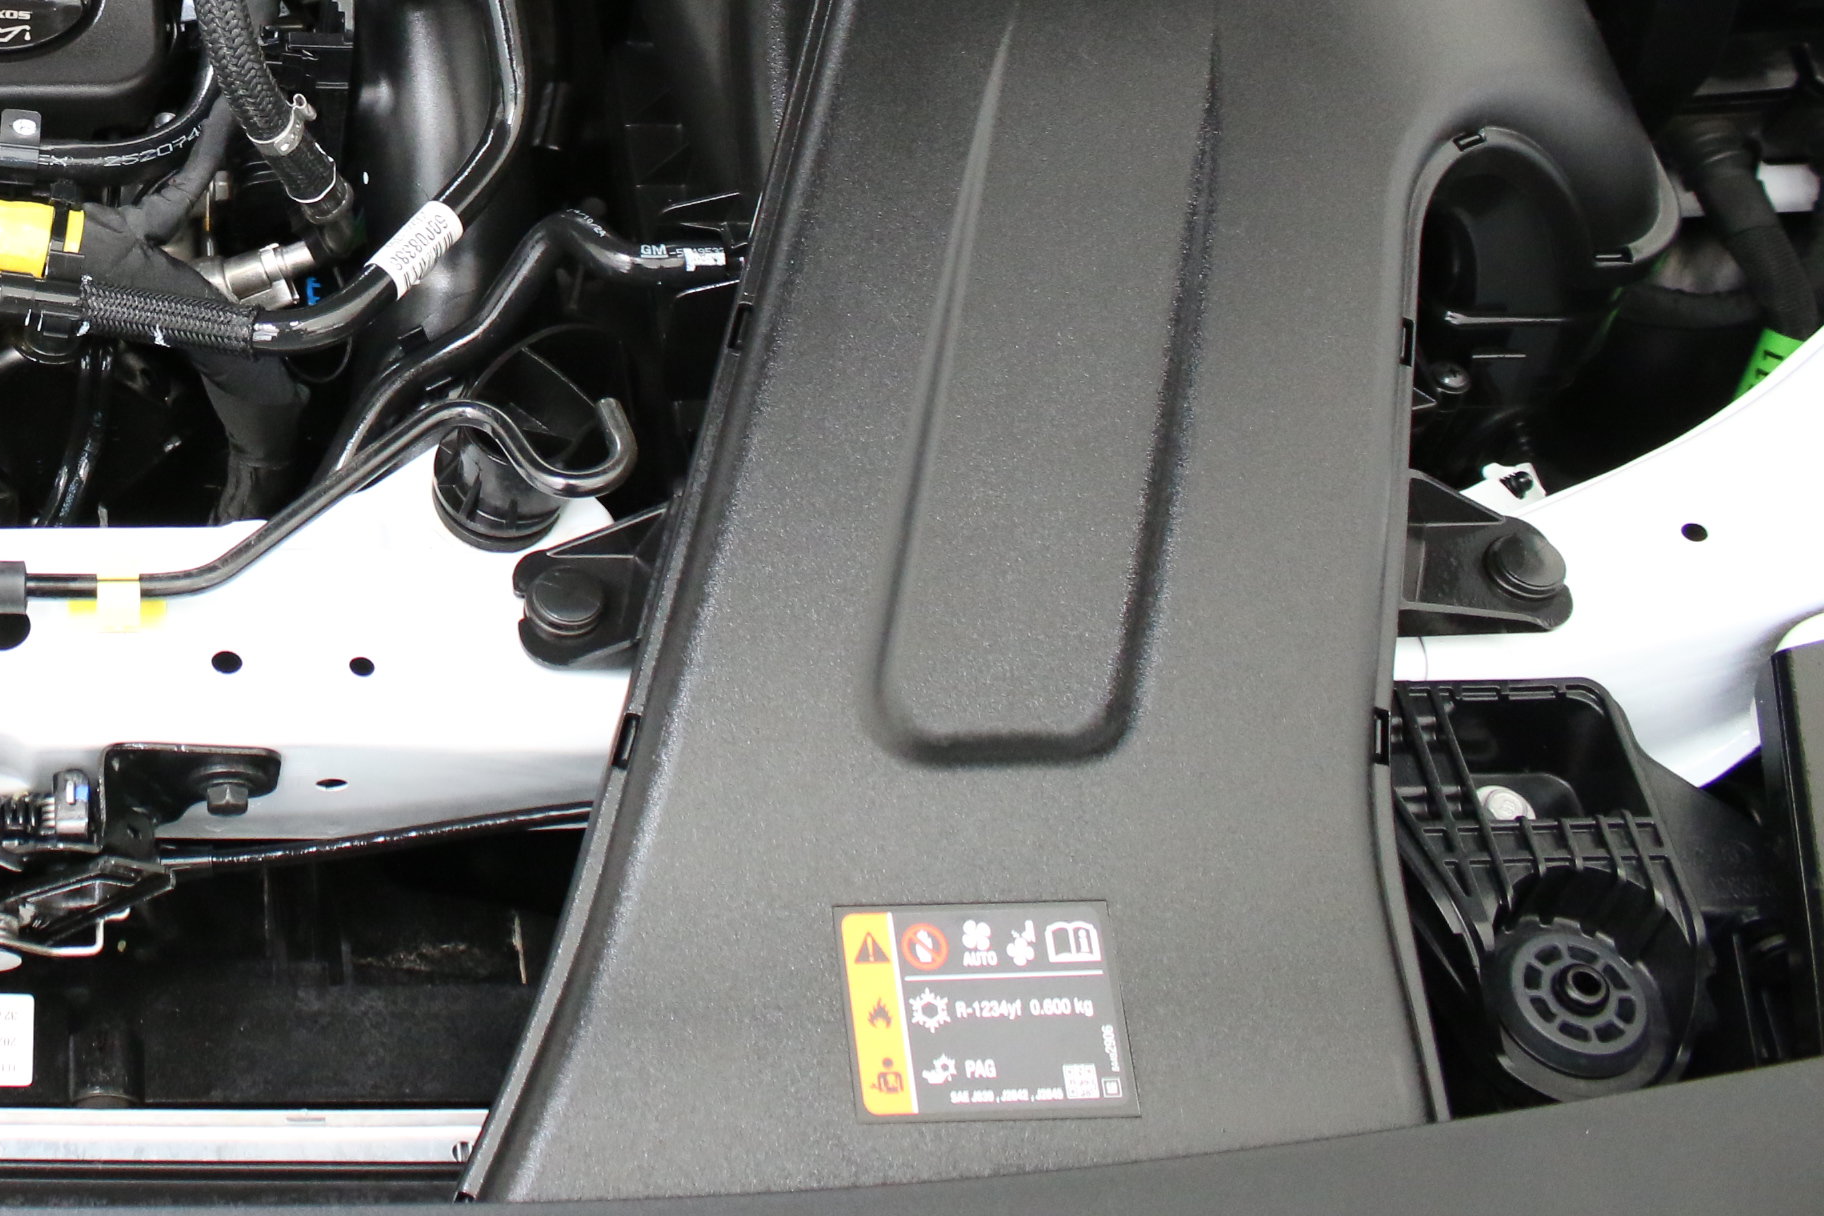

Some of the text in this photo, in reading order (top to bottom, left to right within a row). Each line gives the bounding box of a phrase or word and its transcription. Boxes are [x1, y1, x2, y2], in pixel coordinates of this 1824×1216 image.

[38, 154, 69, 167] EX
[103, 124, 202, 167] 252074
[640, 243, 669, 259] GM
[962, 951, 998, 968] AUTO
[954, 998, 1022, 1021] R-1234yf
[1074, 996, 1094, 1017] kg
[964, 1058, 997, 1079] PAG
